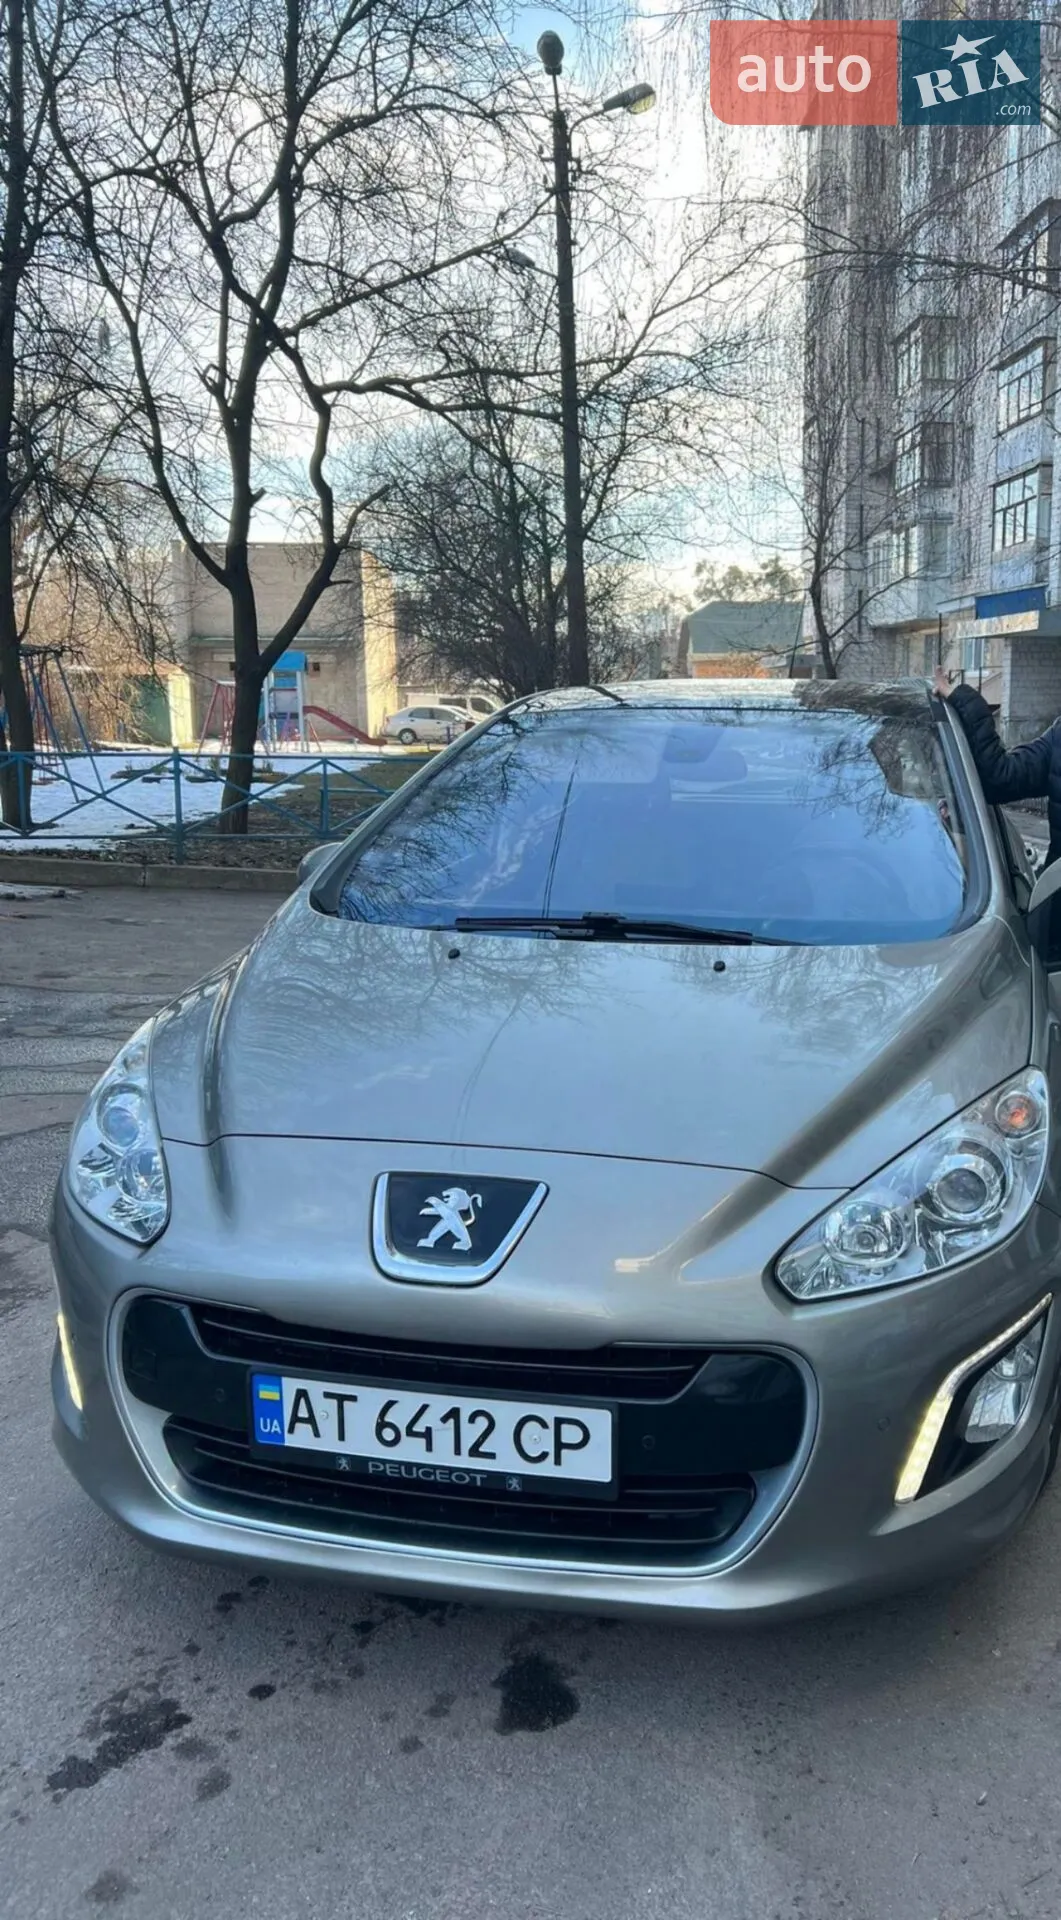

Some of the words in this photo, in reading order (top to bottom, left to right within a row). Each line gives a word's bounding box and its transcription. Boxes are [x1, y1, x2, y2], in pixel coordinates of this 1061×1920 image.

[259, 1417, 281, 1435] UA
[287, 1387, 358, 1442] AT
[374, 1399, 497, 1460] 6412
[512, 1414, 591, 1466] CP
[367, 1461, 488, 1487] PEUGEOT
